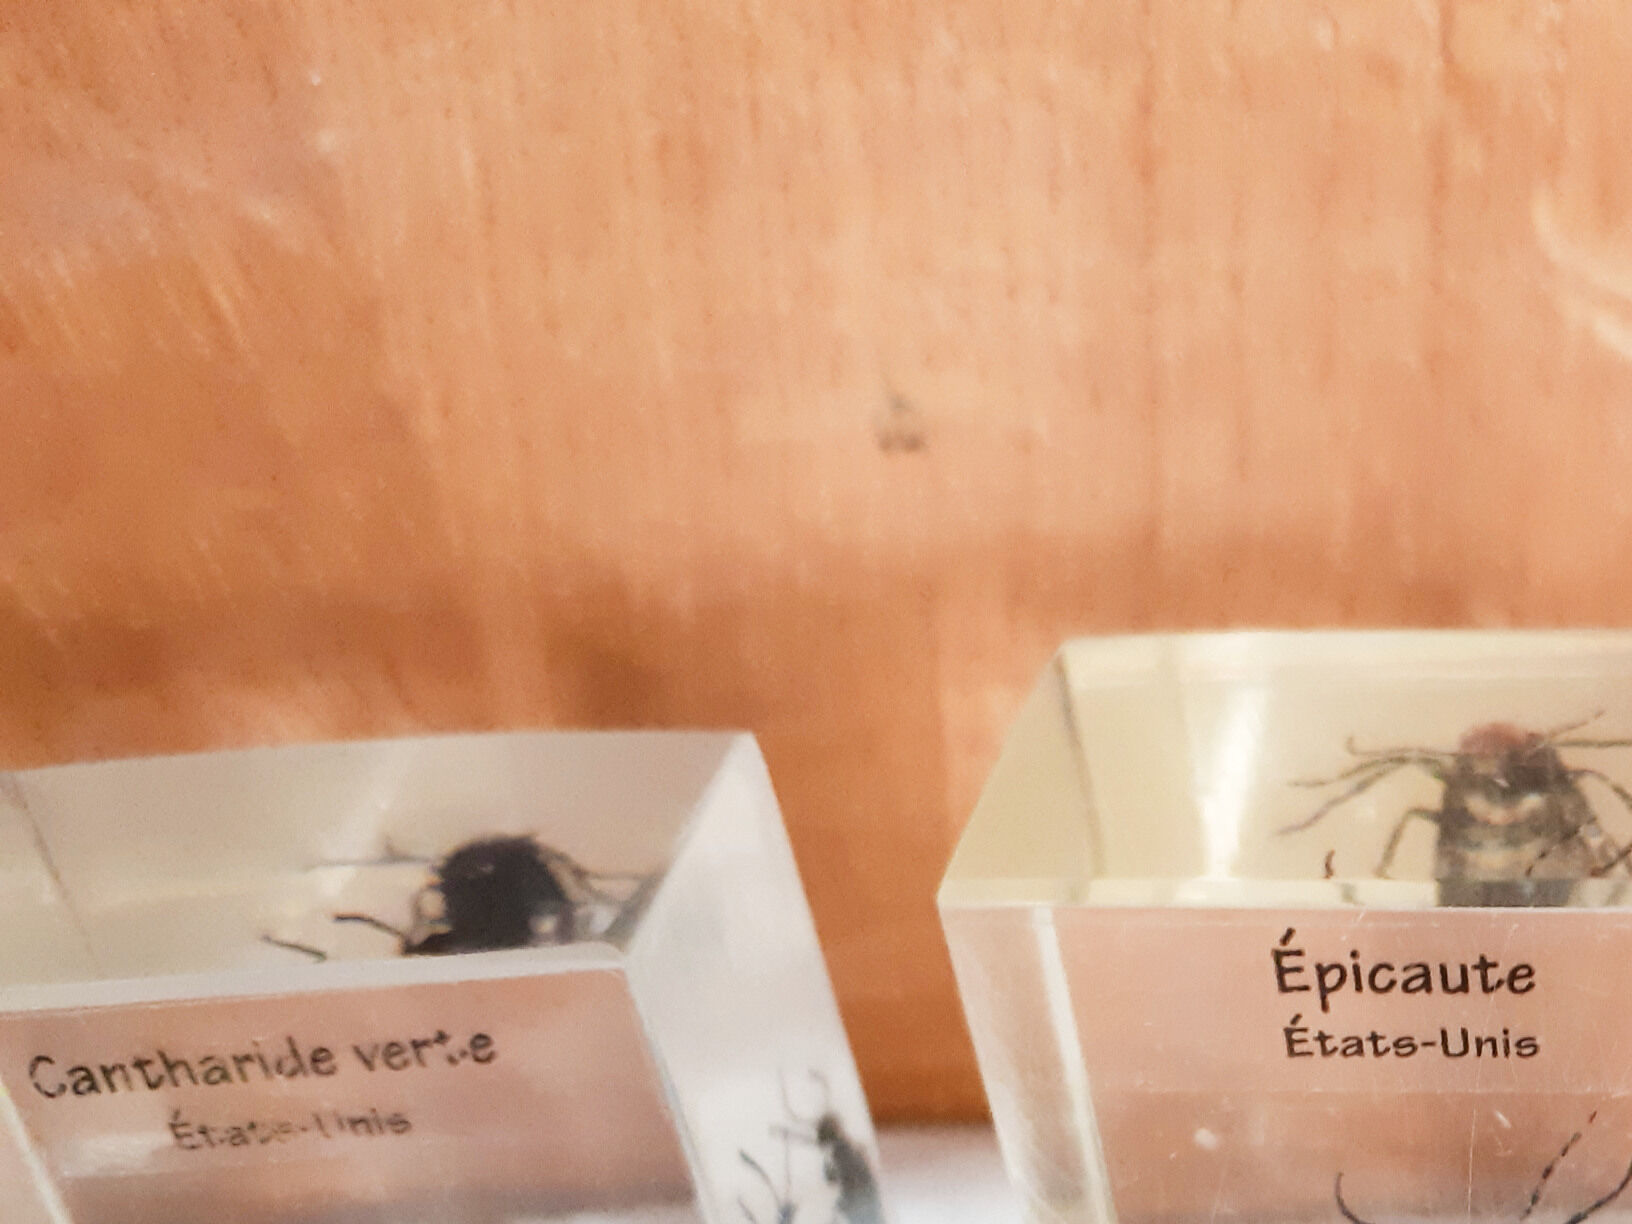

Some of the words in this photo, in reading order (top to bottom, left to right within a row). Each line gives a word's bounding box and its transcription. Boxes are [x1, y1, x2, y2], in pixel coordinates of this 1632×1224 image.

[1272, 927, 1537, 1014] Épicaute
[28, 1035, 338, 1099] Cantharide
[1283, 1013, 1542, 1059] États-Unis
